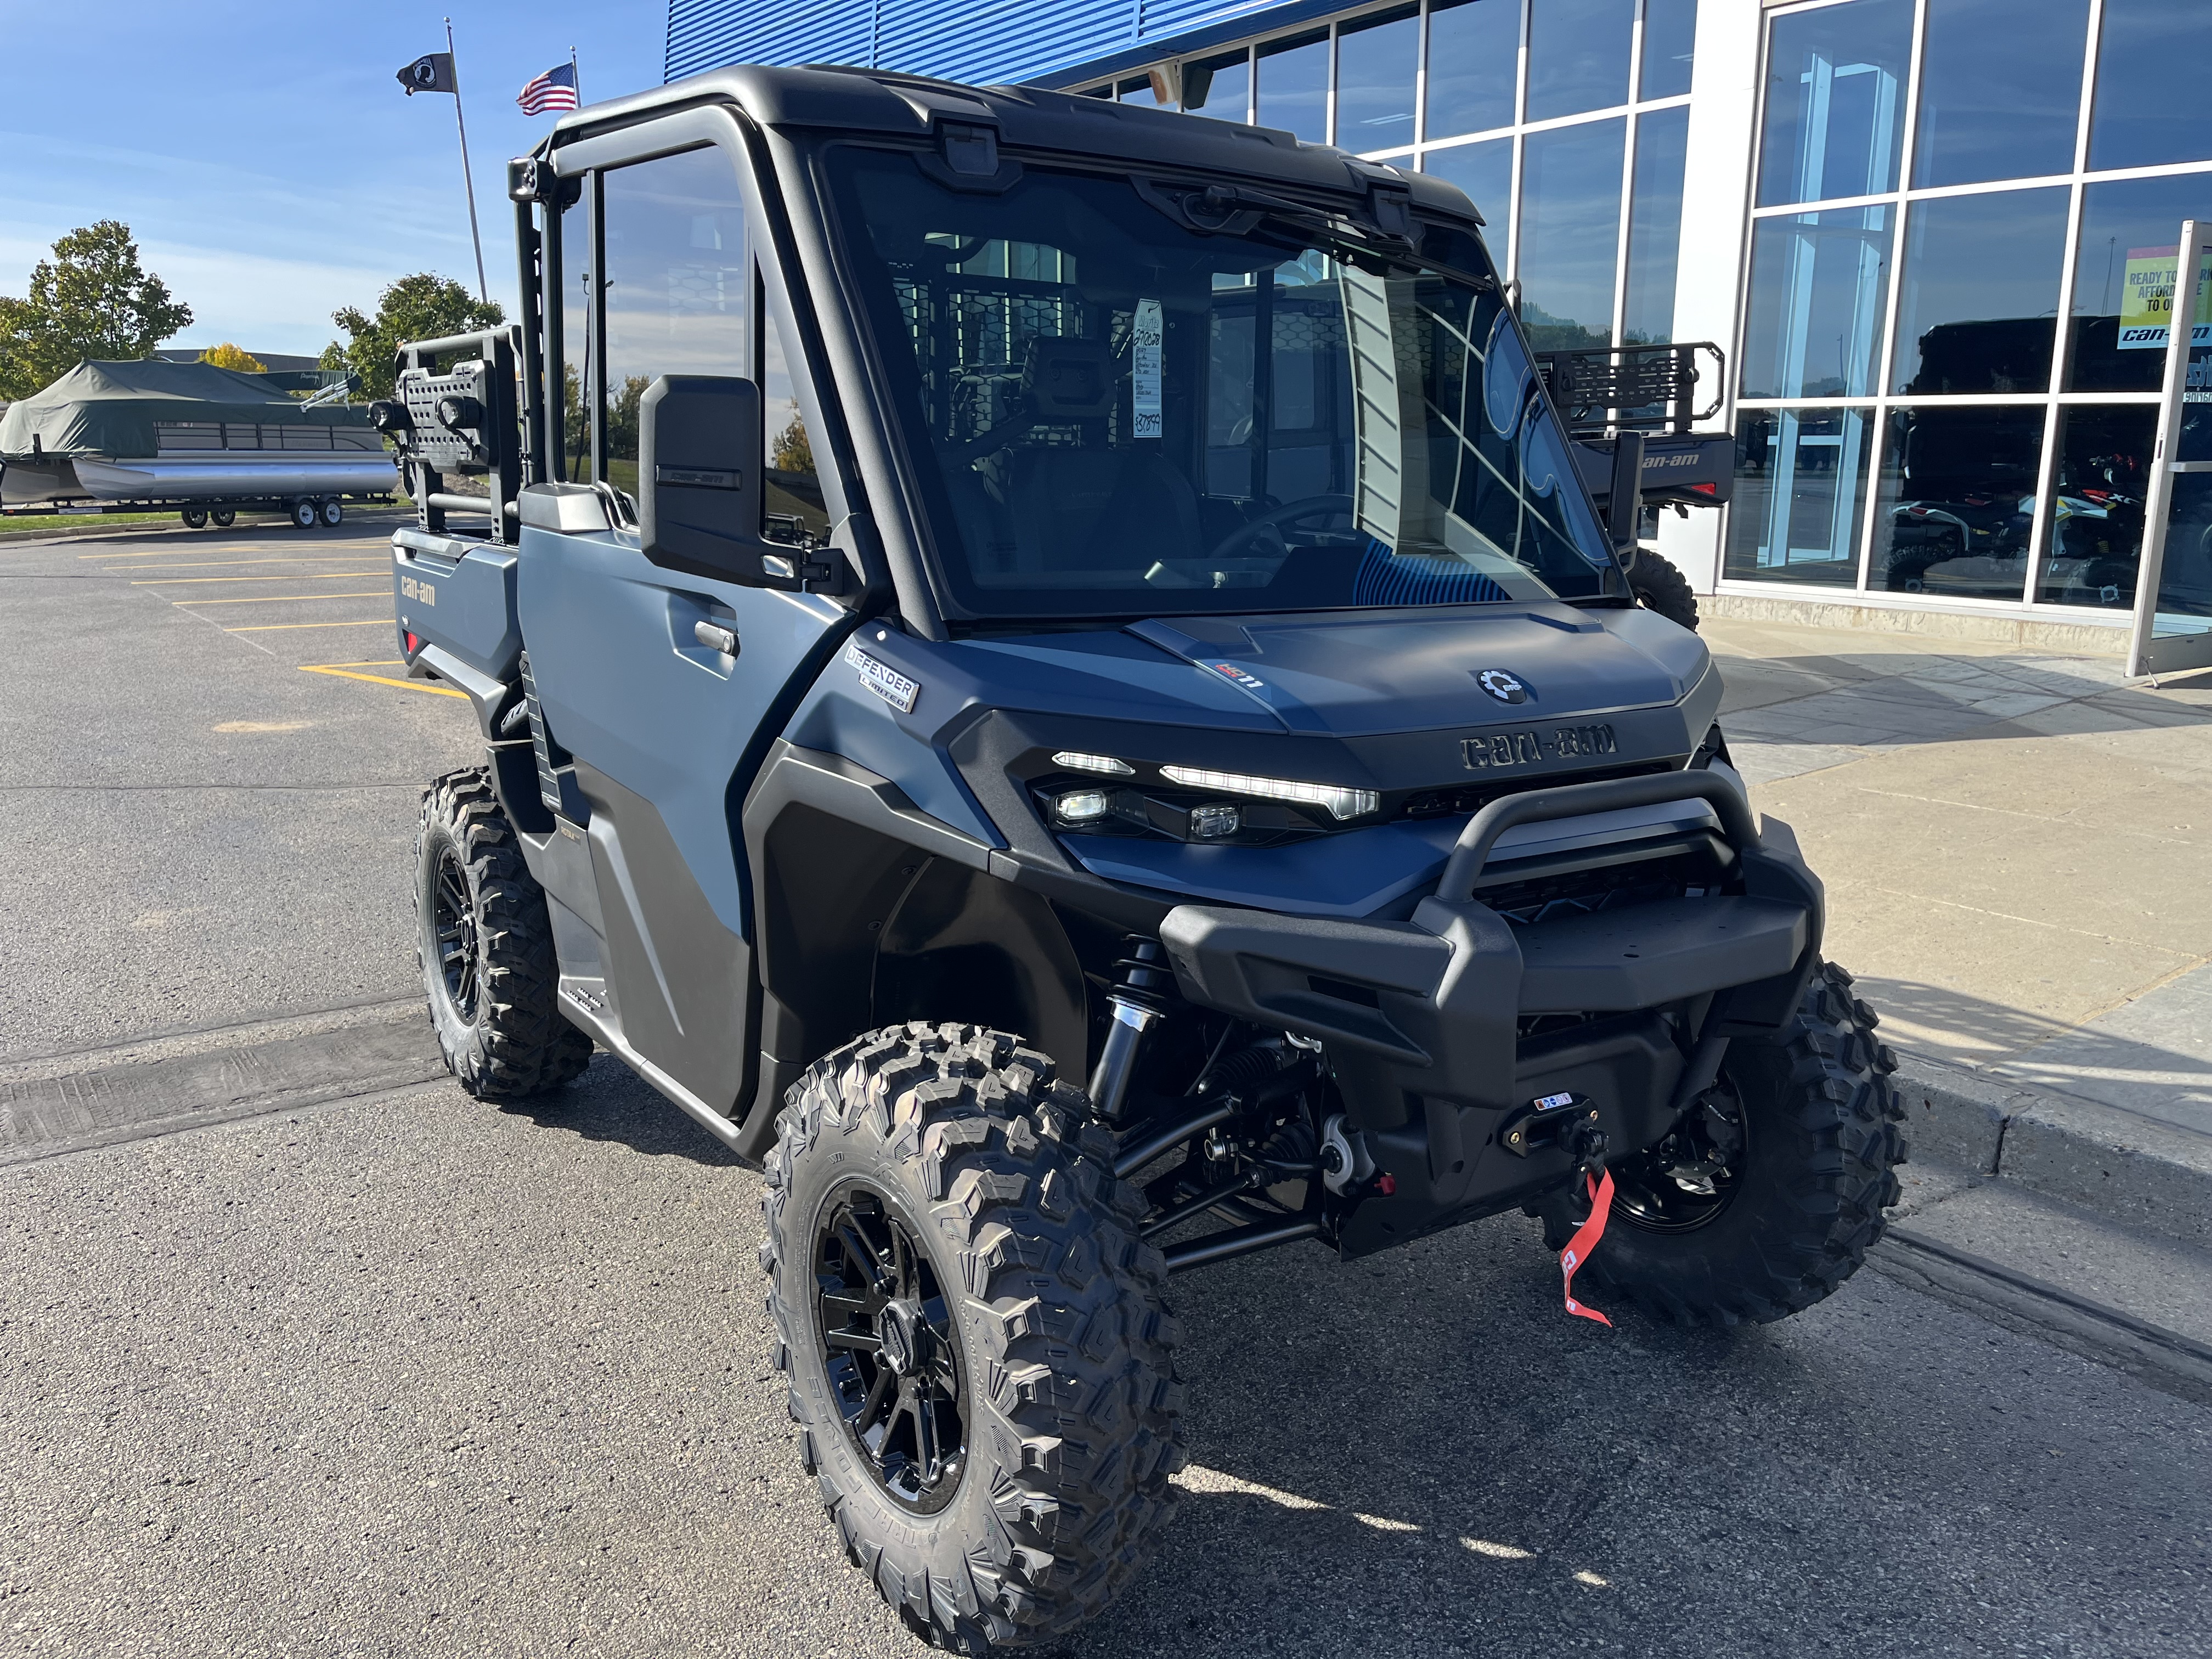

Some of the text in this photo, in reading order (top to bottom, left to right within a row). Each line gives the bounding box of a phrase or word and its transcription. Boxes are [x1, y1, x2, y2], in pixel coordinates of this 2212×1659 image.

[2129, 271, 2162, 285] READY
[2147, 299, 2159, 312] TO
[1138, 315, 1159, 329] Moritz
[2122, 326, 2210, 341] can-m
[1641, 454, 1699, 469] an-am
[401, 575, 435, 607] can-am
[847, 648, 912, 696] DEFENDER
[862, 677, 905, 707] LIMITED
[1459, 724, 1618, 770] can-am
